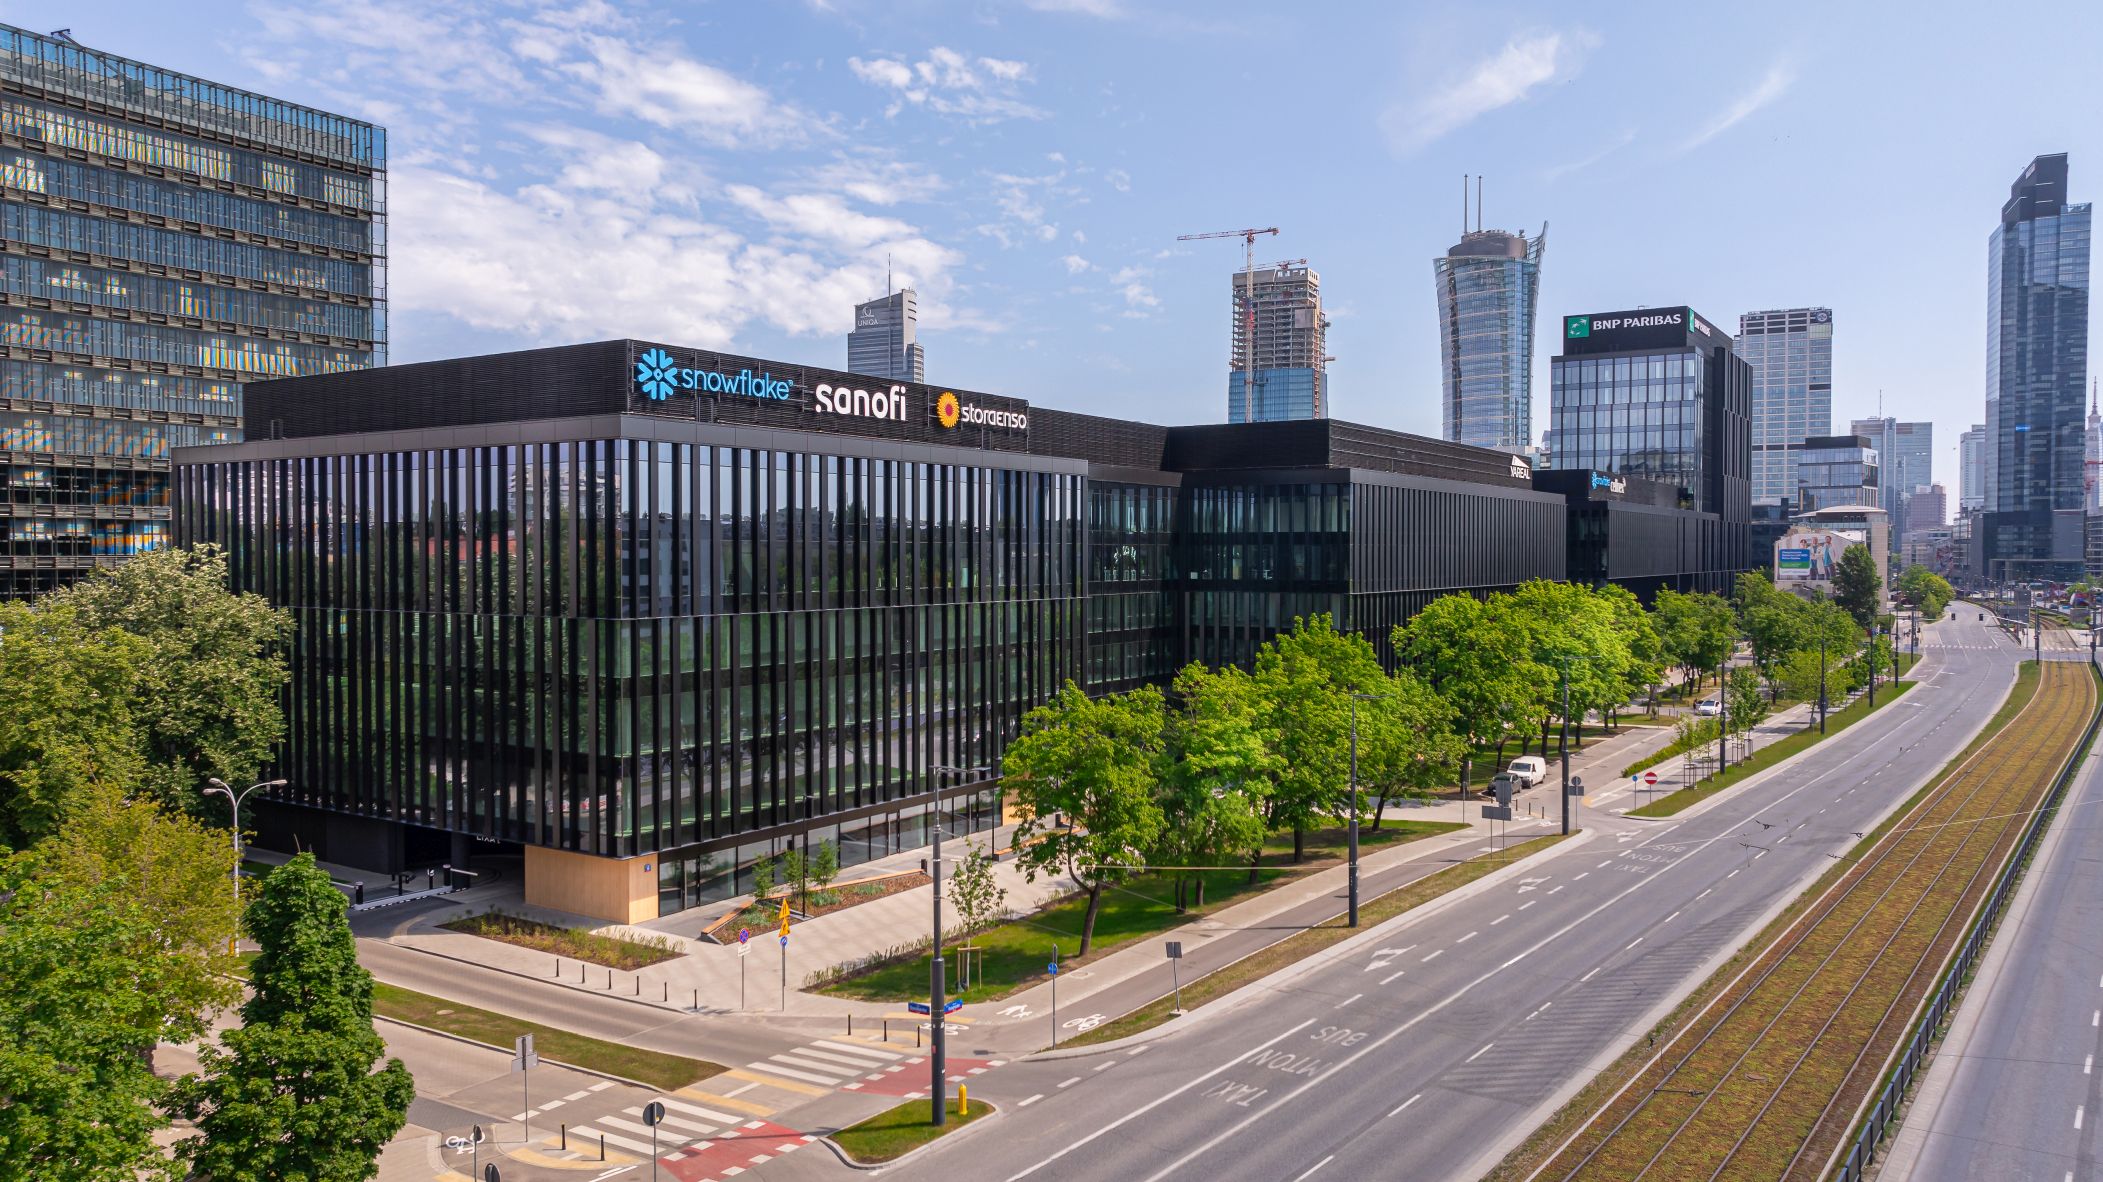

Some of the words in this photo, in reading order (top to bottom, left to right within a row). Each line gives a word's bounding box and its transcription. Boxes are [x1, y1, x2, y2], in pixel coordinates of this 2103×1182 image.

[857, 318, 879, 327] UNIQA
[1592, 318, 1622, 331] BNP
[1623, 313, 1682, 328] PARIBAS
[815, 383, 907, 421] sanofi
[1310, 1026, 1369, 1047] BUS
[1200, 1079, 1268, 1107] TAXI
